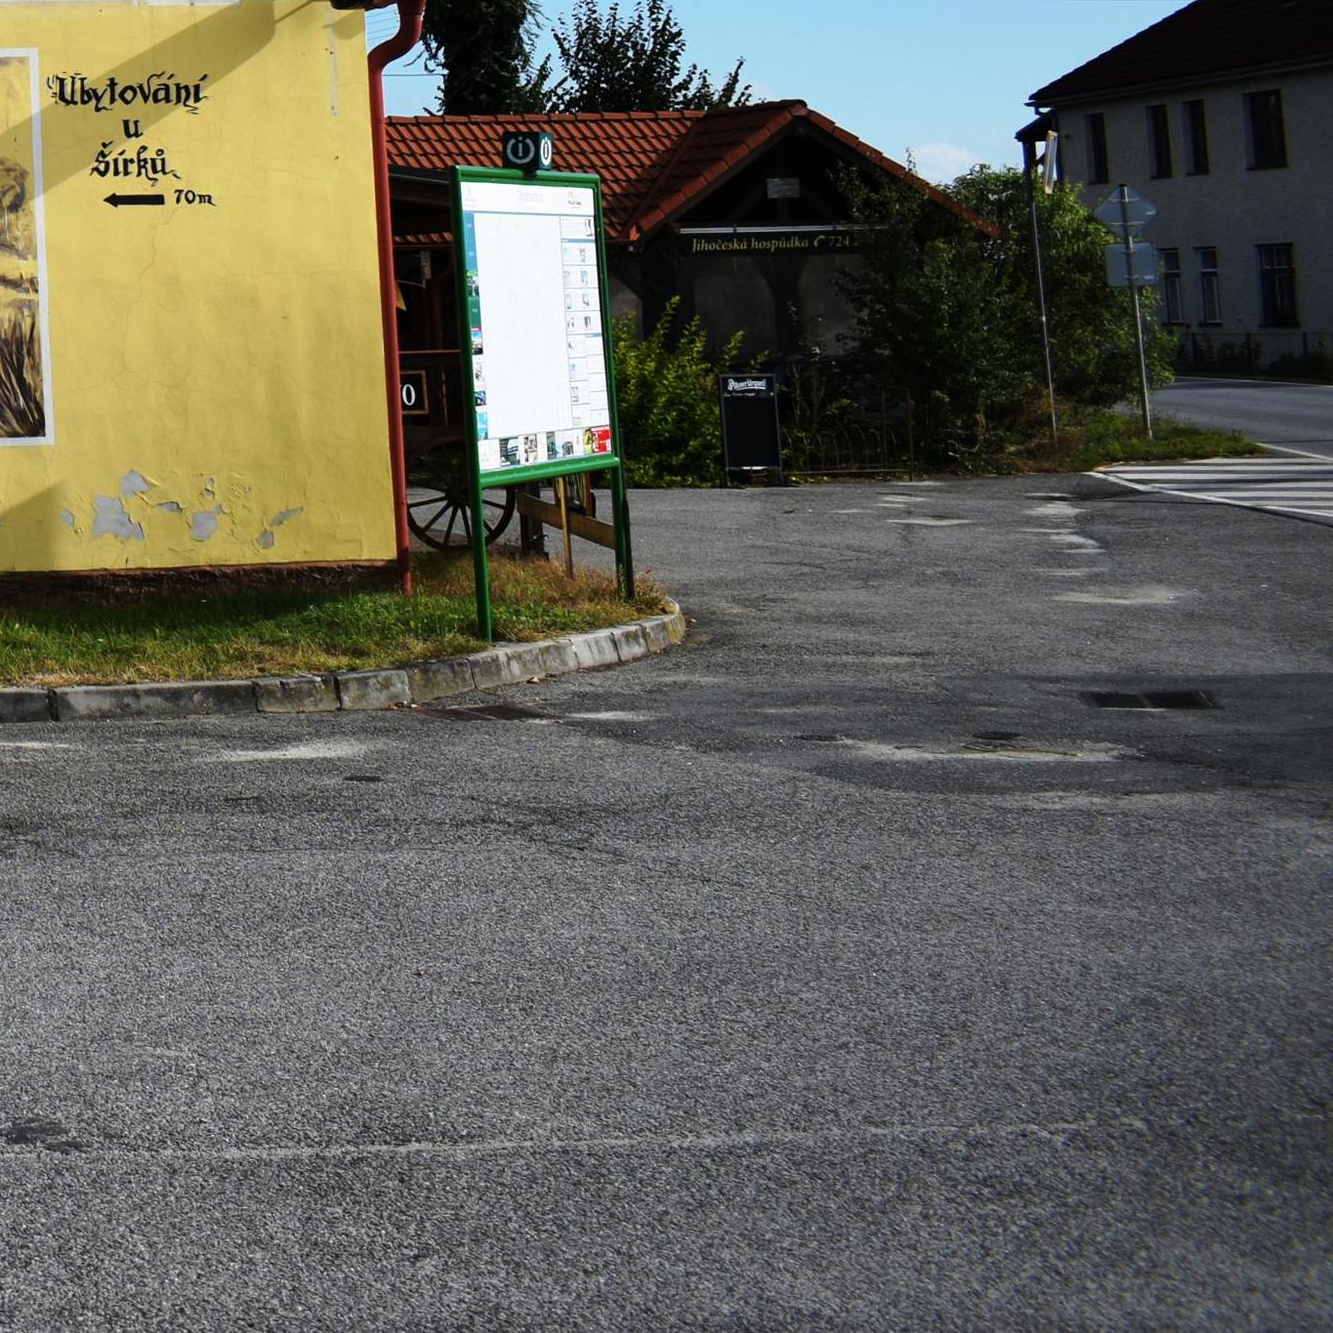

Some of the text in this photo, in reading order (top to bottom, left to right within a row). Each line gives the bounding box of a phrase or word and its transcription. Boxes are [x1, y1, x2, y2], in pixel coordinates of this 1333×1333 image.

[54, 71, 209, 113] Ubytování
[122, 119, 143, 139] u
[692, 237, 748, 253] Jihočeská
[750, 234, 809, 253] hospůdka
[829, 235, 850, 247] 724
[399, 383, 416, 406] 0
